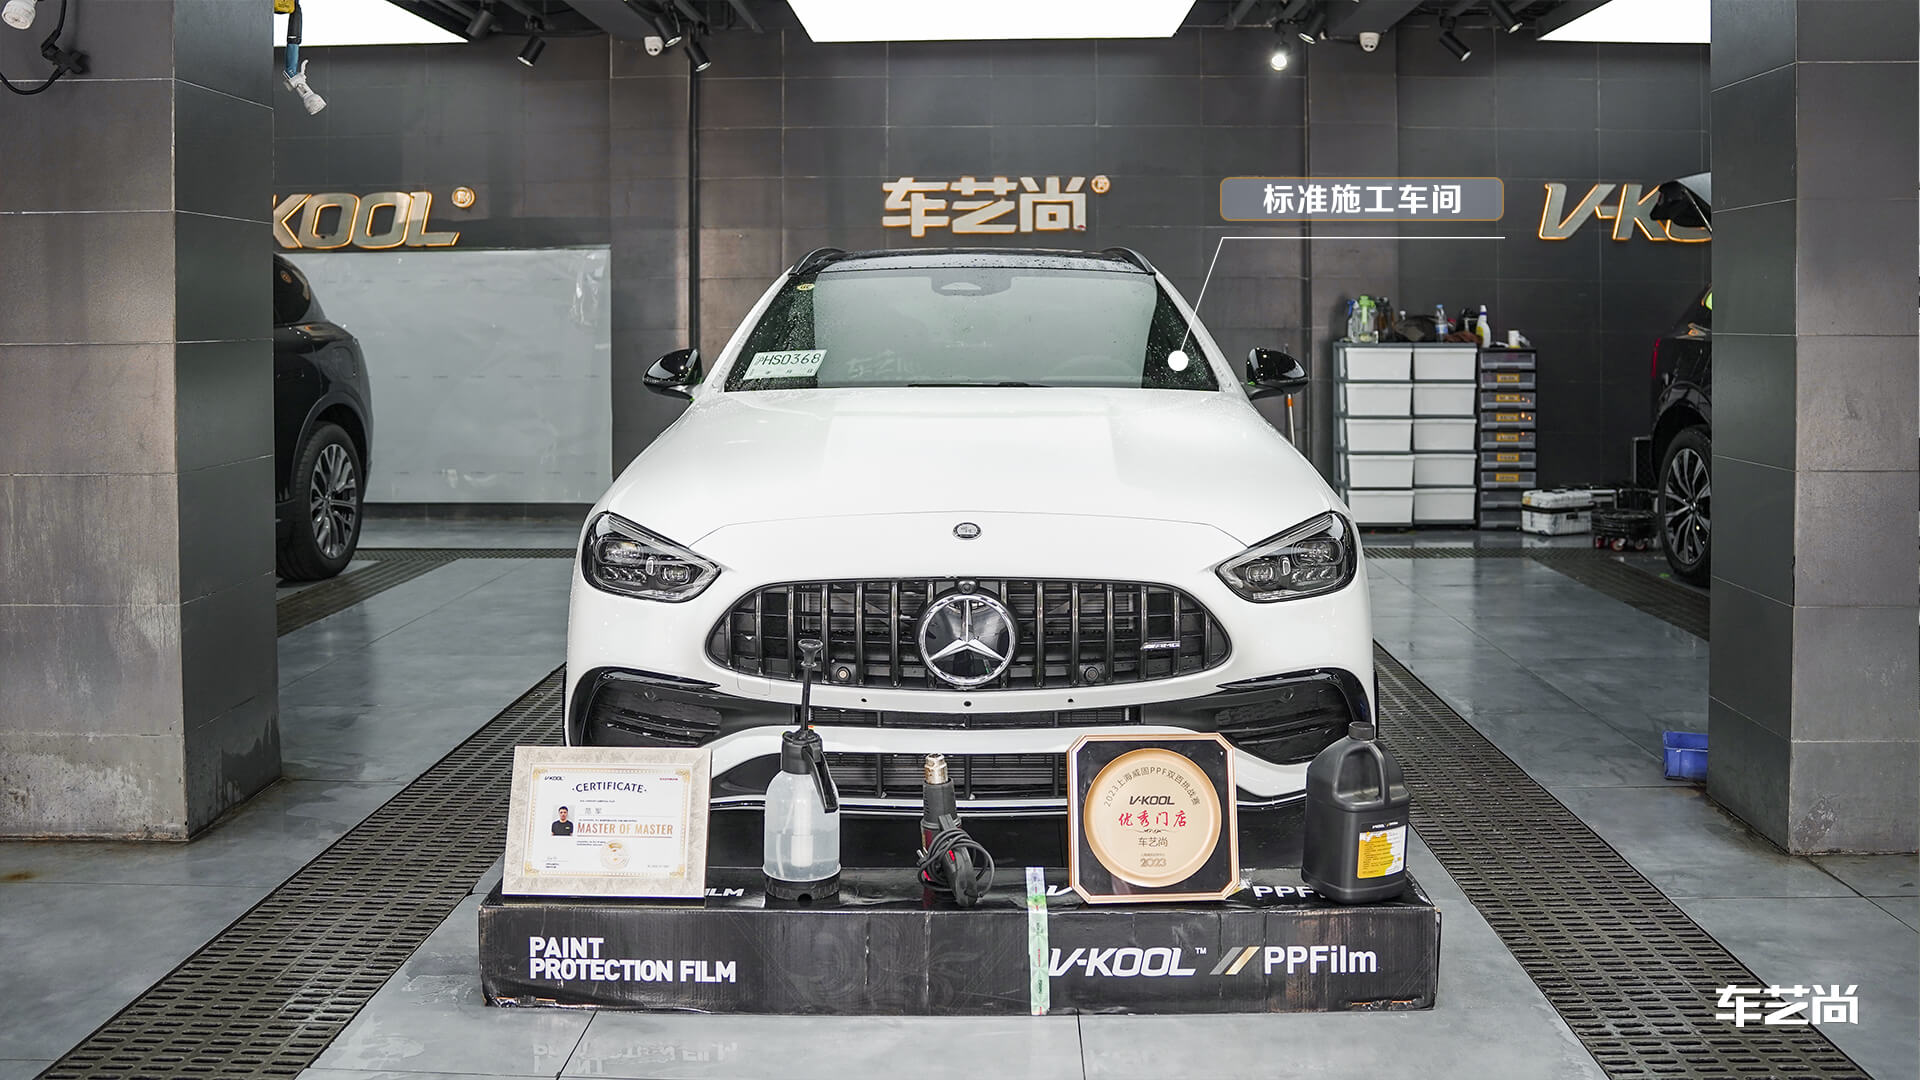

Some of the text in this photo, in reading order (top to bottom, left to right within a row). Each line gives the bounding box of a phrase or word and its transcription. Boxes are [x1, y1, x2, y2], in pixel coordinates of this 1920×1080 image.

[882, 176, 1086, 237] 车艺尚
[575, 781, 644, 793] CERTIFICATE
[1129, 796, 1175, 805] V-KOOL
[1119, 810, 1187, 827] 优秀门店
[577, 823, 673, 835] MASTER OF MASTER
[1138, 837, 1168, 847] 车艺尚
[1140, 858, 1167, 867] 2023
[530, 936, 604, 959] PAINT
[1264, 945, 1377, 974] PPFilm
[530, 958, 736, 983] PROTECTION FILM
